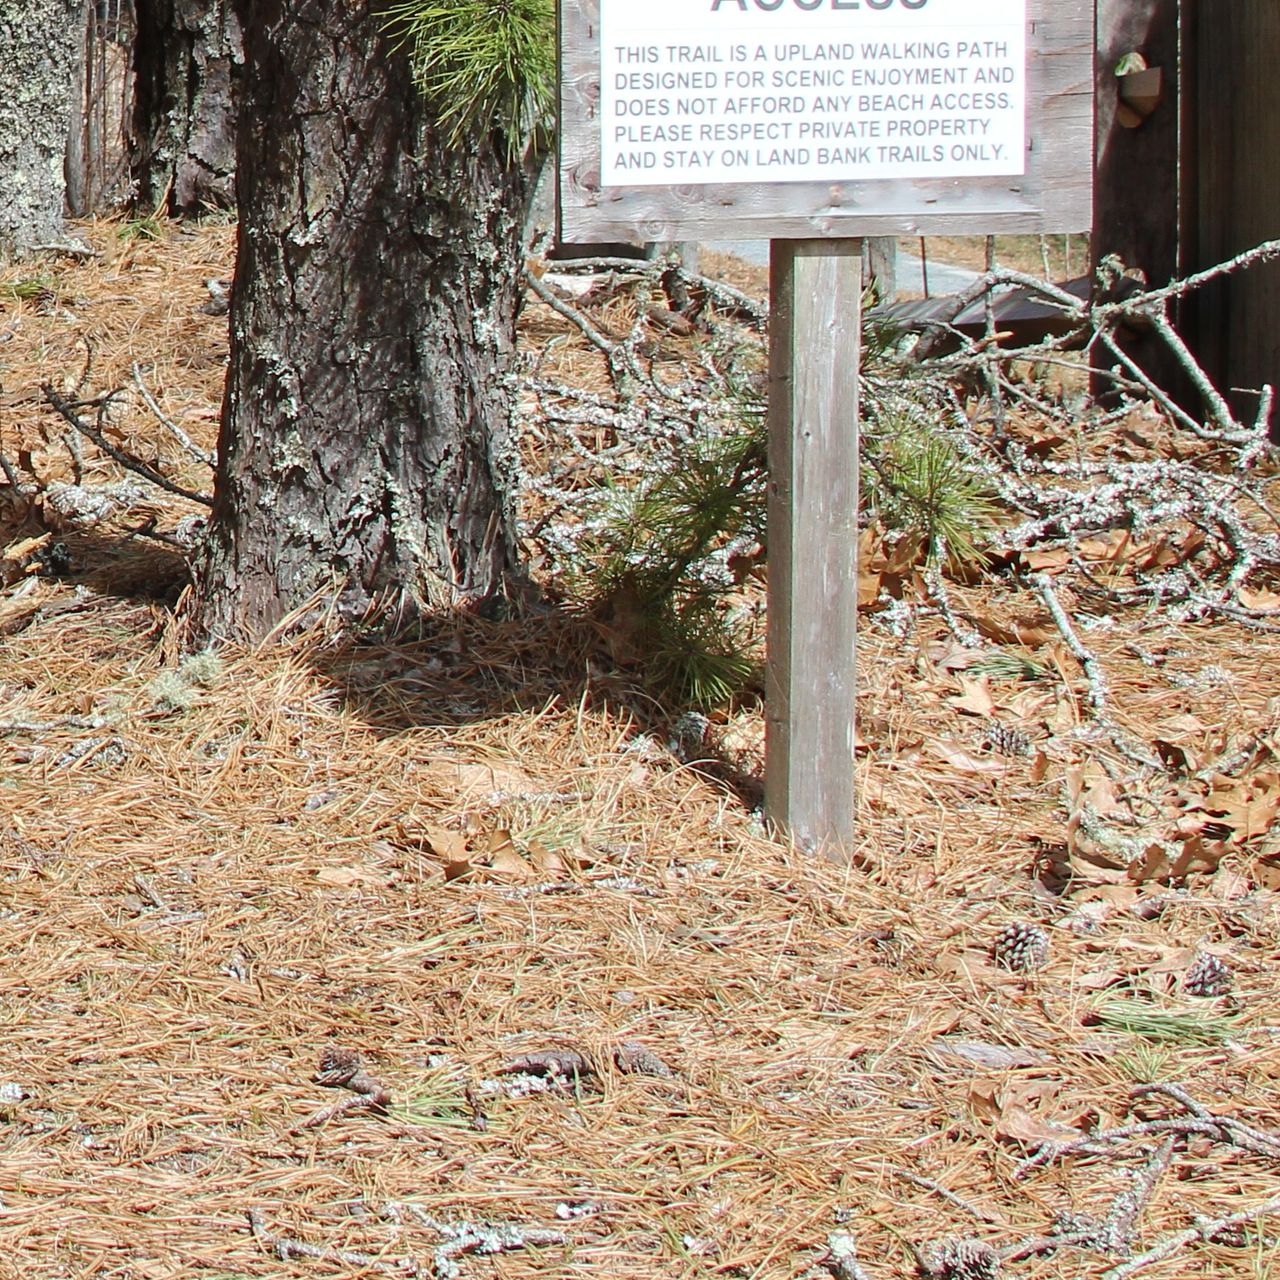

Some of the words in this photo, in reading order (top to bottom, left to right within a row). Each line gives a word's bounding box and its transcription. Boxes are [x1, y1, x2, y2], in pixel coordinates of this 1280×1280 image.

[615, 46, 659, 63] THIS
[666, 45, 723, 62] TRAIL
[730, 45, 747, 62] IS
[754, 45, 767, 61] A
[774, 43, 855, 61] UPLAND
[861, 42, 950, 59] WALKING
[957, 41, 1007, 58] PATH
[615, 72, 717, 90] DESIGNED
[724, 71, 765, 88] FOR
[772, 69, 845, 87] SCENIC
[852, 68, 968, 86] ENJOYMENT
[974, 67, 1014, 84] AND
[615, 99, 670, 116] DOES
[677, 98, 717, 115] NOT
[724, 97, 805, 114] AFFORD
[812, 96, 852, 112] ANY
[859, 94, 924, 112] BEACH
[930, 93, 1014, 110] ACCESS.
[615, 125, 692, 142] PLEASE
[700, 123, 792, 141] RESPECT
[799, 121, 880, 139] PRIVATE
[887, 119, 991, 136] PROPERTY
[615, 152, 656, 169] AND
[663, 151, 714, 168] STAY
[721, 150, 749, 167] ON
[756, 149, 810, 165] LAND
[817, 147, 871, 164] BANK
[877, 145, 944, 162] TRAILS
[951, 144, 1008, 161] ONLY.
